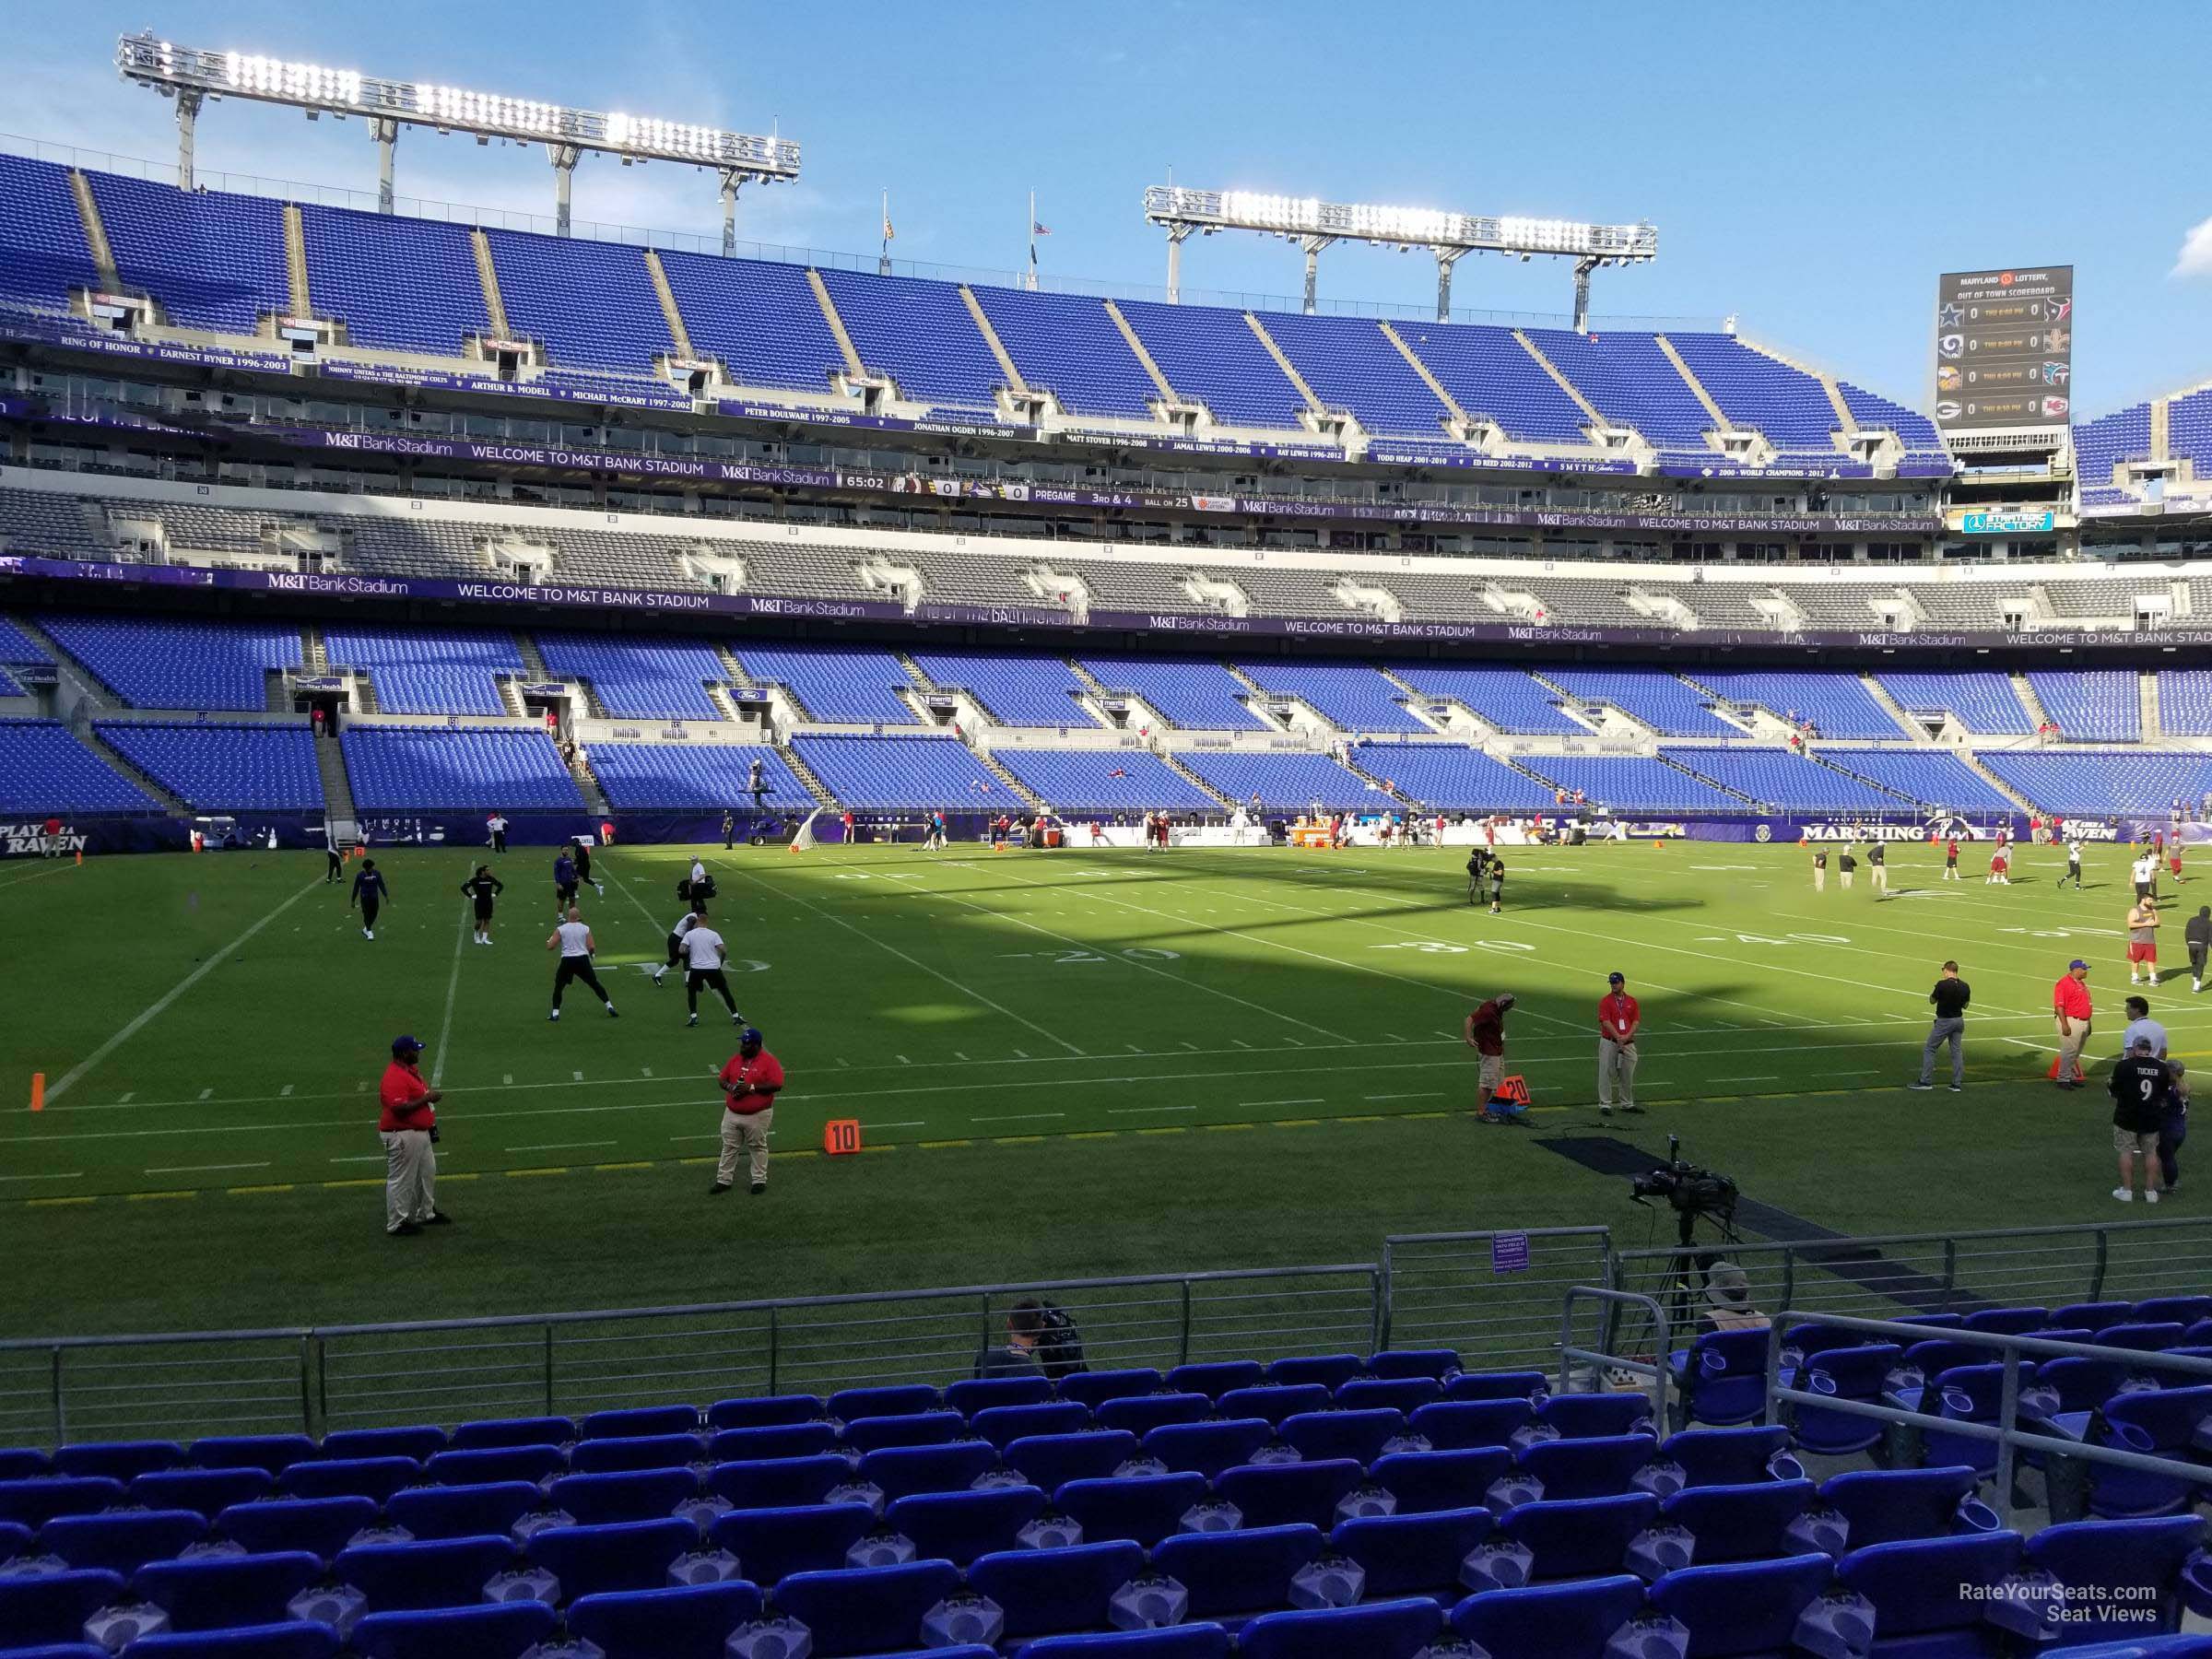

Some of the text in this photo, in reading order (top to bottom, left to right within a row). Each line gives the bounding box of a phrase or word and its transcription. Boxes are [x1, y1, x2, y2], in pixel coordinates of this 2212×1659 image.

[1960, 274, 2046, 286] MARYLAND LOTTERY
[1958, 287, 2055, 300] OUT OF TOWN SCOREBOARD
[1971, 308, 1978, 319] 0
[2030, 304, 2039, 315] 0
[62, 336, 87, 347] RING
[89, 340, 103, 349] OF
[105, 341, 141, 354] HONOR
[1970, 339, 1977, 350] 0
[2030, 336, 2038, 347] 0
[160, 349, 287, 371] EARNEST BYNER 1996-2003
[328, 366, 352, 374] JOHNNY
[354, 369, 375, 377] UNITAS
[395, 372, 429, 382] BALTIMORE
[1969, 371, 1976, 382] 0
[2029, 369, 2037, 379] 0
[471, 382, 551, 396] ARTHUR B. MODELL
[572, 392, 690, 410] MICHAEL McCRARY 1997-2002
[1968, 404, 1975, 415] 0
[2028, 401, 2036, 412] 0
[745, 408, 850, 424] PETER BOULWARE 1997-2005
[913, 423, 1015, 438] JONATHAN OGDEN 1996-2007
[325, 432, 453, 456] M&T Bank Stadium
[1086, 437, 1111, 445] STOVER
[1112, 438, 1147, 447] 1996-2008
[1173, 442, 1252, 454] JAMAL LEWIS 2000-2006
[471, 445, 704, 476] WELCOME TO M&T BANK STADIUM
[1310, 451, 1342, 459] 1996-2012
[1377, 454, 1447, 465] TODD HEAP 2001-2010
[1500, 460, 1533, 469] 2002-2012
[722, 465, 830, 486] M&T Bank Stadium
[847, 477, 884, 489] 65:02
[943, 484, 952, 494] 0
[1013, 491, 1022, 500] 0
[1035, 490, 1077, 502] PREGAME
[1092, 494, 1111, 504] 3RD
[1112, 495, 1122, 504] &
[1124, 496, 1133, 505] 4
[1175, 498, 1188, 508] 25
[1242, 500, 1335, 516] M&T Bank Stadium
[1537, 514, 1625, 528] M&T Bank Stadium
[1639, 517, 1819, 531] WELCOME TO M&T BANK STADIUM
[1835, 520, 1934, 531] M&T Bank Stadium
[1986, 522, 2045, 531] FACTORY
[267, 573, 407, 594] M&T Bank Stadium
[457, 583, 709, 608] WELCOME TO M&T BANK STADIUM
[750, 598, 865, 617] M&T Bank Stadium
[1149, 616, 1250, 631] M&T Bank Stadium
[1285, 621, 1475, 637] WELCOME TO M&T BANK STADIUM
[1508, 627, 1601, 641] M&T Bank Stadium
[1860, 633, 1966, 647] M&T Bank Stadium
[2006, 633, 2075, 645] WELCOME
[2078, 633, 2097, 644] TO
[2101, 633, 2132, 644] M&T
[2135, 632, 2173, 643] BANK
[741, 691, 758, 700] Ford
[930, 697, 952, 705] merritt
[0, 825, 43, 838] PLAY
[1800, 826, 1926, 841] MARCHING
[7, 836, 88, 853] RAVEN
[2137, 1066, 2159, 1077] TUCKER
[1506, 1079, 1528, 1101] 20
[2139, 1079, 2153, 1100] 9
[832, 1124, 856, 1151] 10
